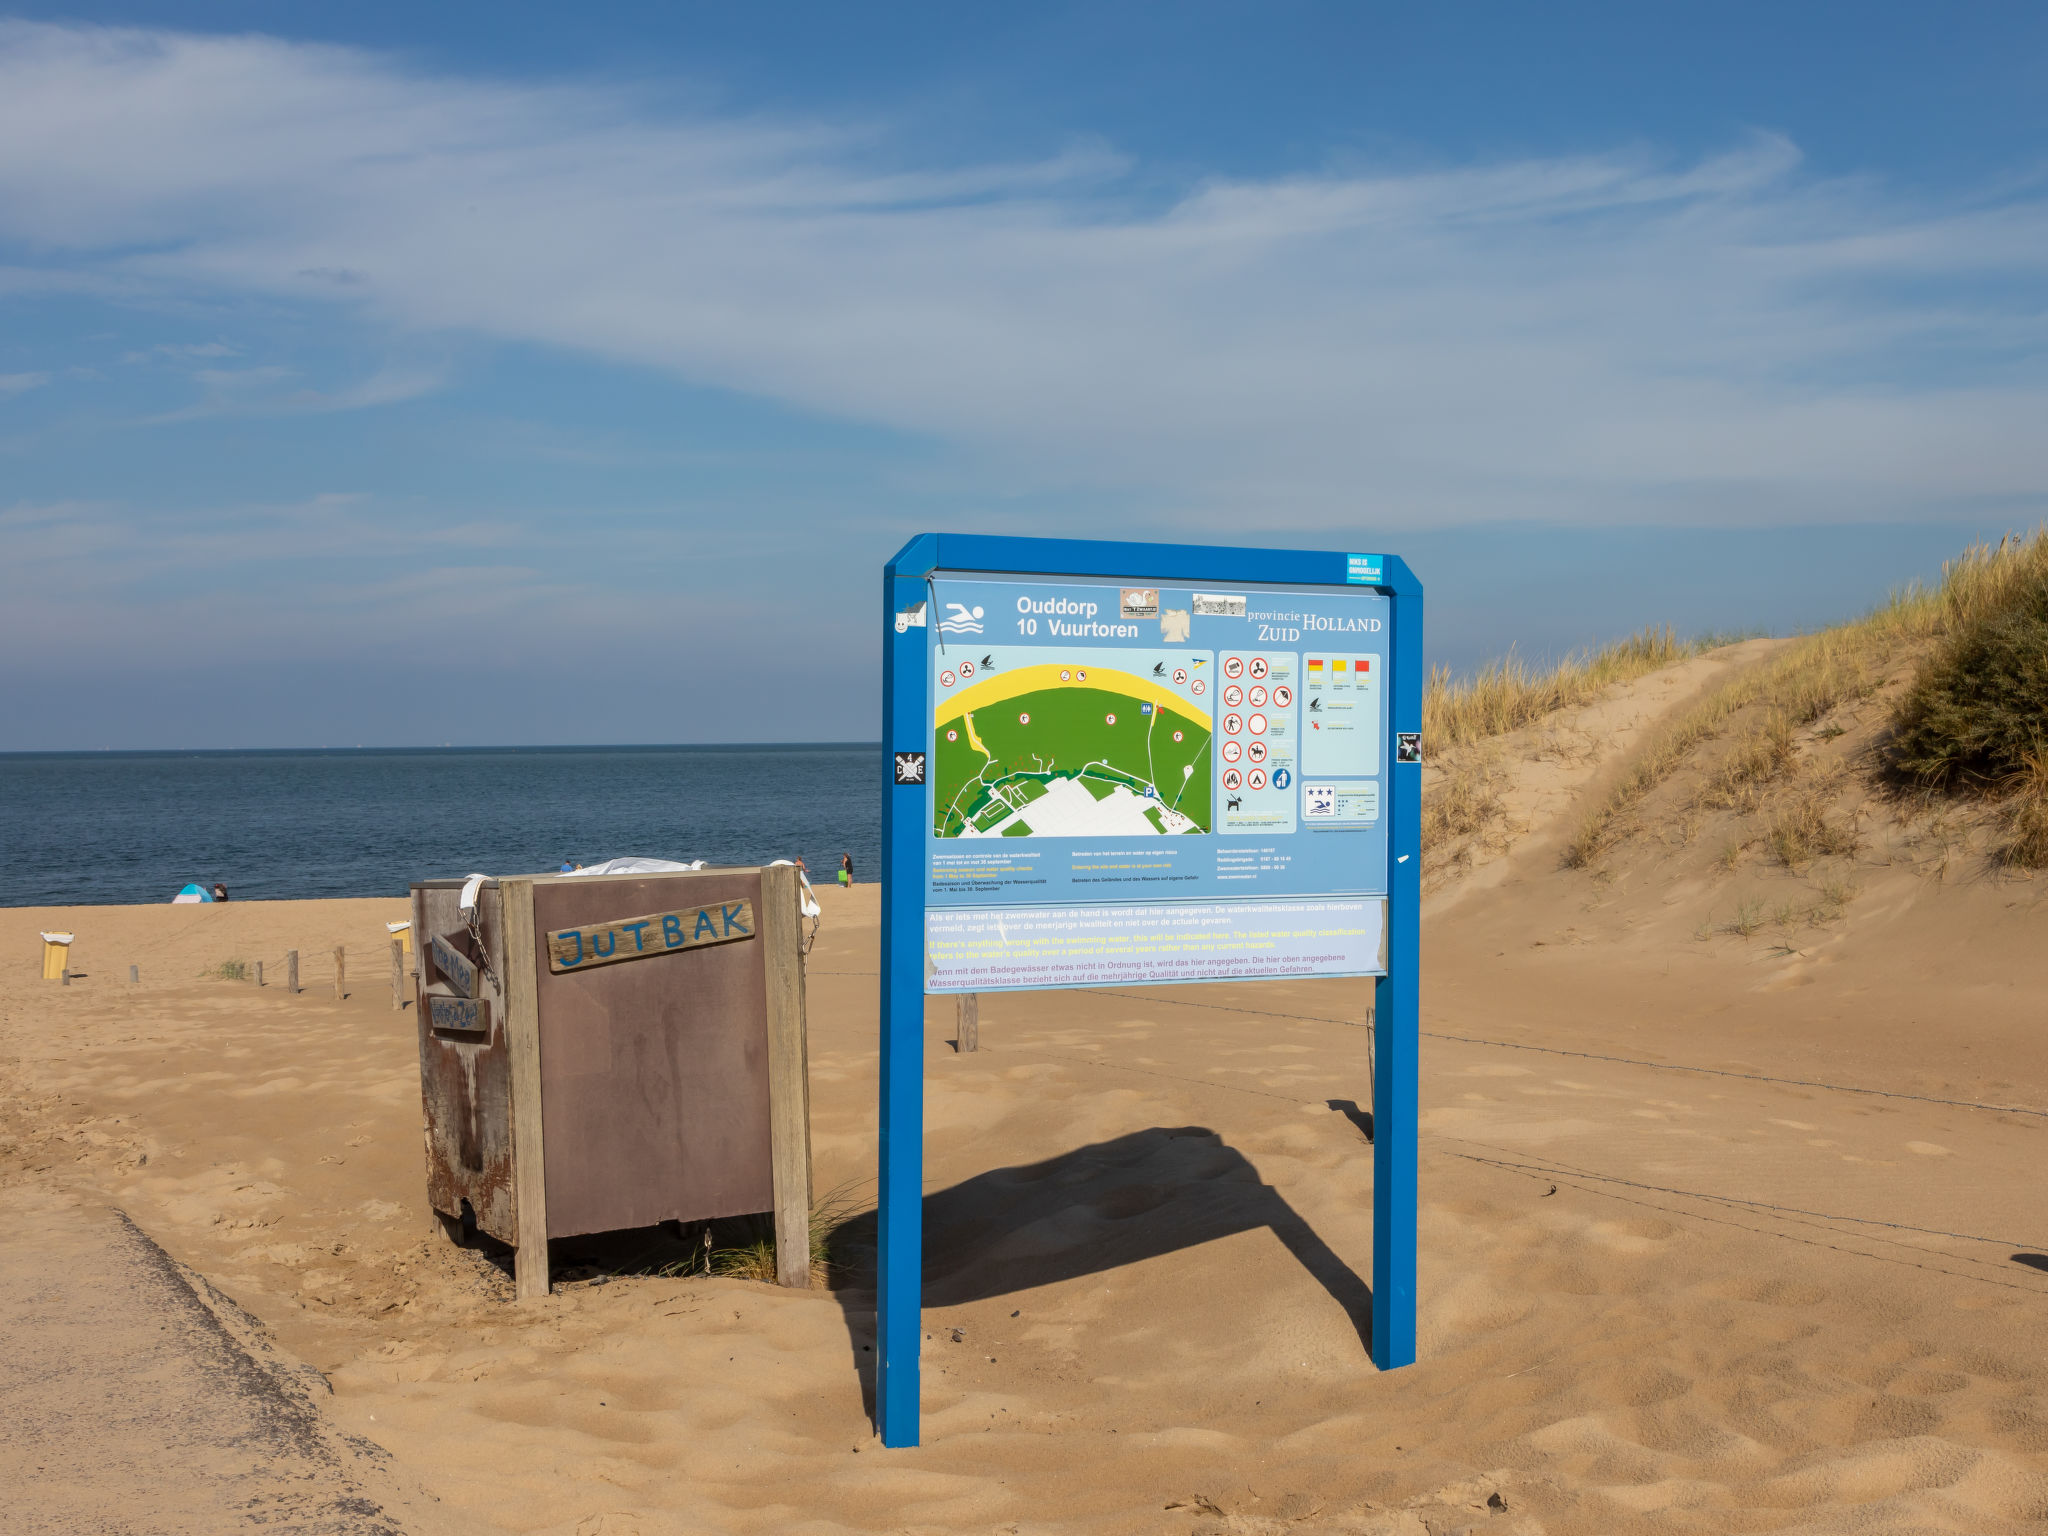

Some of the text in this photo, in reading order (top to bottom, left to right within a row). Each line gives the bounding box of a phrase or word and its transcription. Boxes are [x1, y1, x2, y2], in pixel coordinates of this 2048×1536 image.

[1017, 596, 1098, 618] Ouddorp
[1248, 610, 1300, 622] provincie
[1017, 618, 1138, 638] 10 Vuurtoren
[1258, 614, 1381, 642] ZUID HOLLAND
[918, 766, 923, 774] E
[974, 912, 988, 920] met
[991, 912, 1003, 920] het
[1005, 911, 1050, 920] zwemwater
[1112, 908, 1132, 916] wordt
[1136, 908, 1146, 916] dat
[1150, 907, 1164, 915] hier
[1166, 908, 1212, 916] aangegeven.
[1228, 904, 1304, 913] waterkwaliteitsklasse
[1327, 904, 1363, 912] hierboven
[558, 904, 748, 966] JUTBAK
[956, 966, 968, 974] mit
[970, 966, 988, 974] dem
[990, 964, 1049, 974] Badegewässer
[1051, 964, 1074, 972] etwas
[1076, 962, 1096, 970] nicht
[1108, 961, 1141, 970] Ordnung
[1144, 960, 1154, 968] ist,
[1157, 959, 1174, 967] wird
[1176, 958, 1188, 966] das
[1208, 958, 1250, 966] angegeben.
[1302, 954, 1346, 963] angegebene
[930, 977, 1020, 988] Wasserqualitätsklasse
[1023, 976, 1052, 984] bezieht
[1054, 974, 1070, 982] sich
[1073, 973, 1085, 981] auf
[1087, 972, 1098, 980] die
[1101, 970, 1146, 980] mehrjährige
[1149, 970, 1178, 978] Qualität
[1181, 968, 1195, 976] und
[1197, 968, 1216, 976] nicht
[1218, 968, 1230, 976] auf
[1245, 966, 1278, 974] aktuellen
[1280, 965, 1314, 974] Gefahren.
